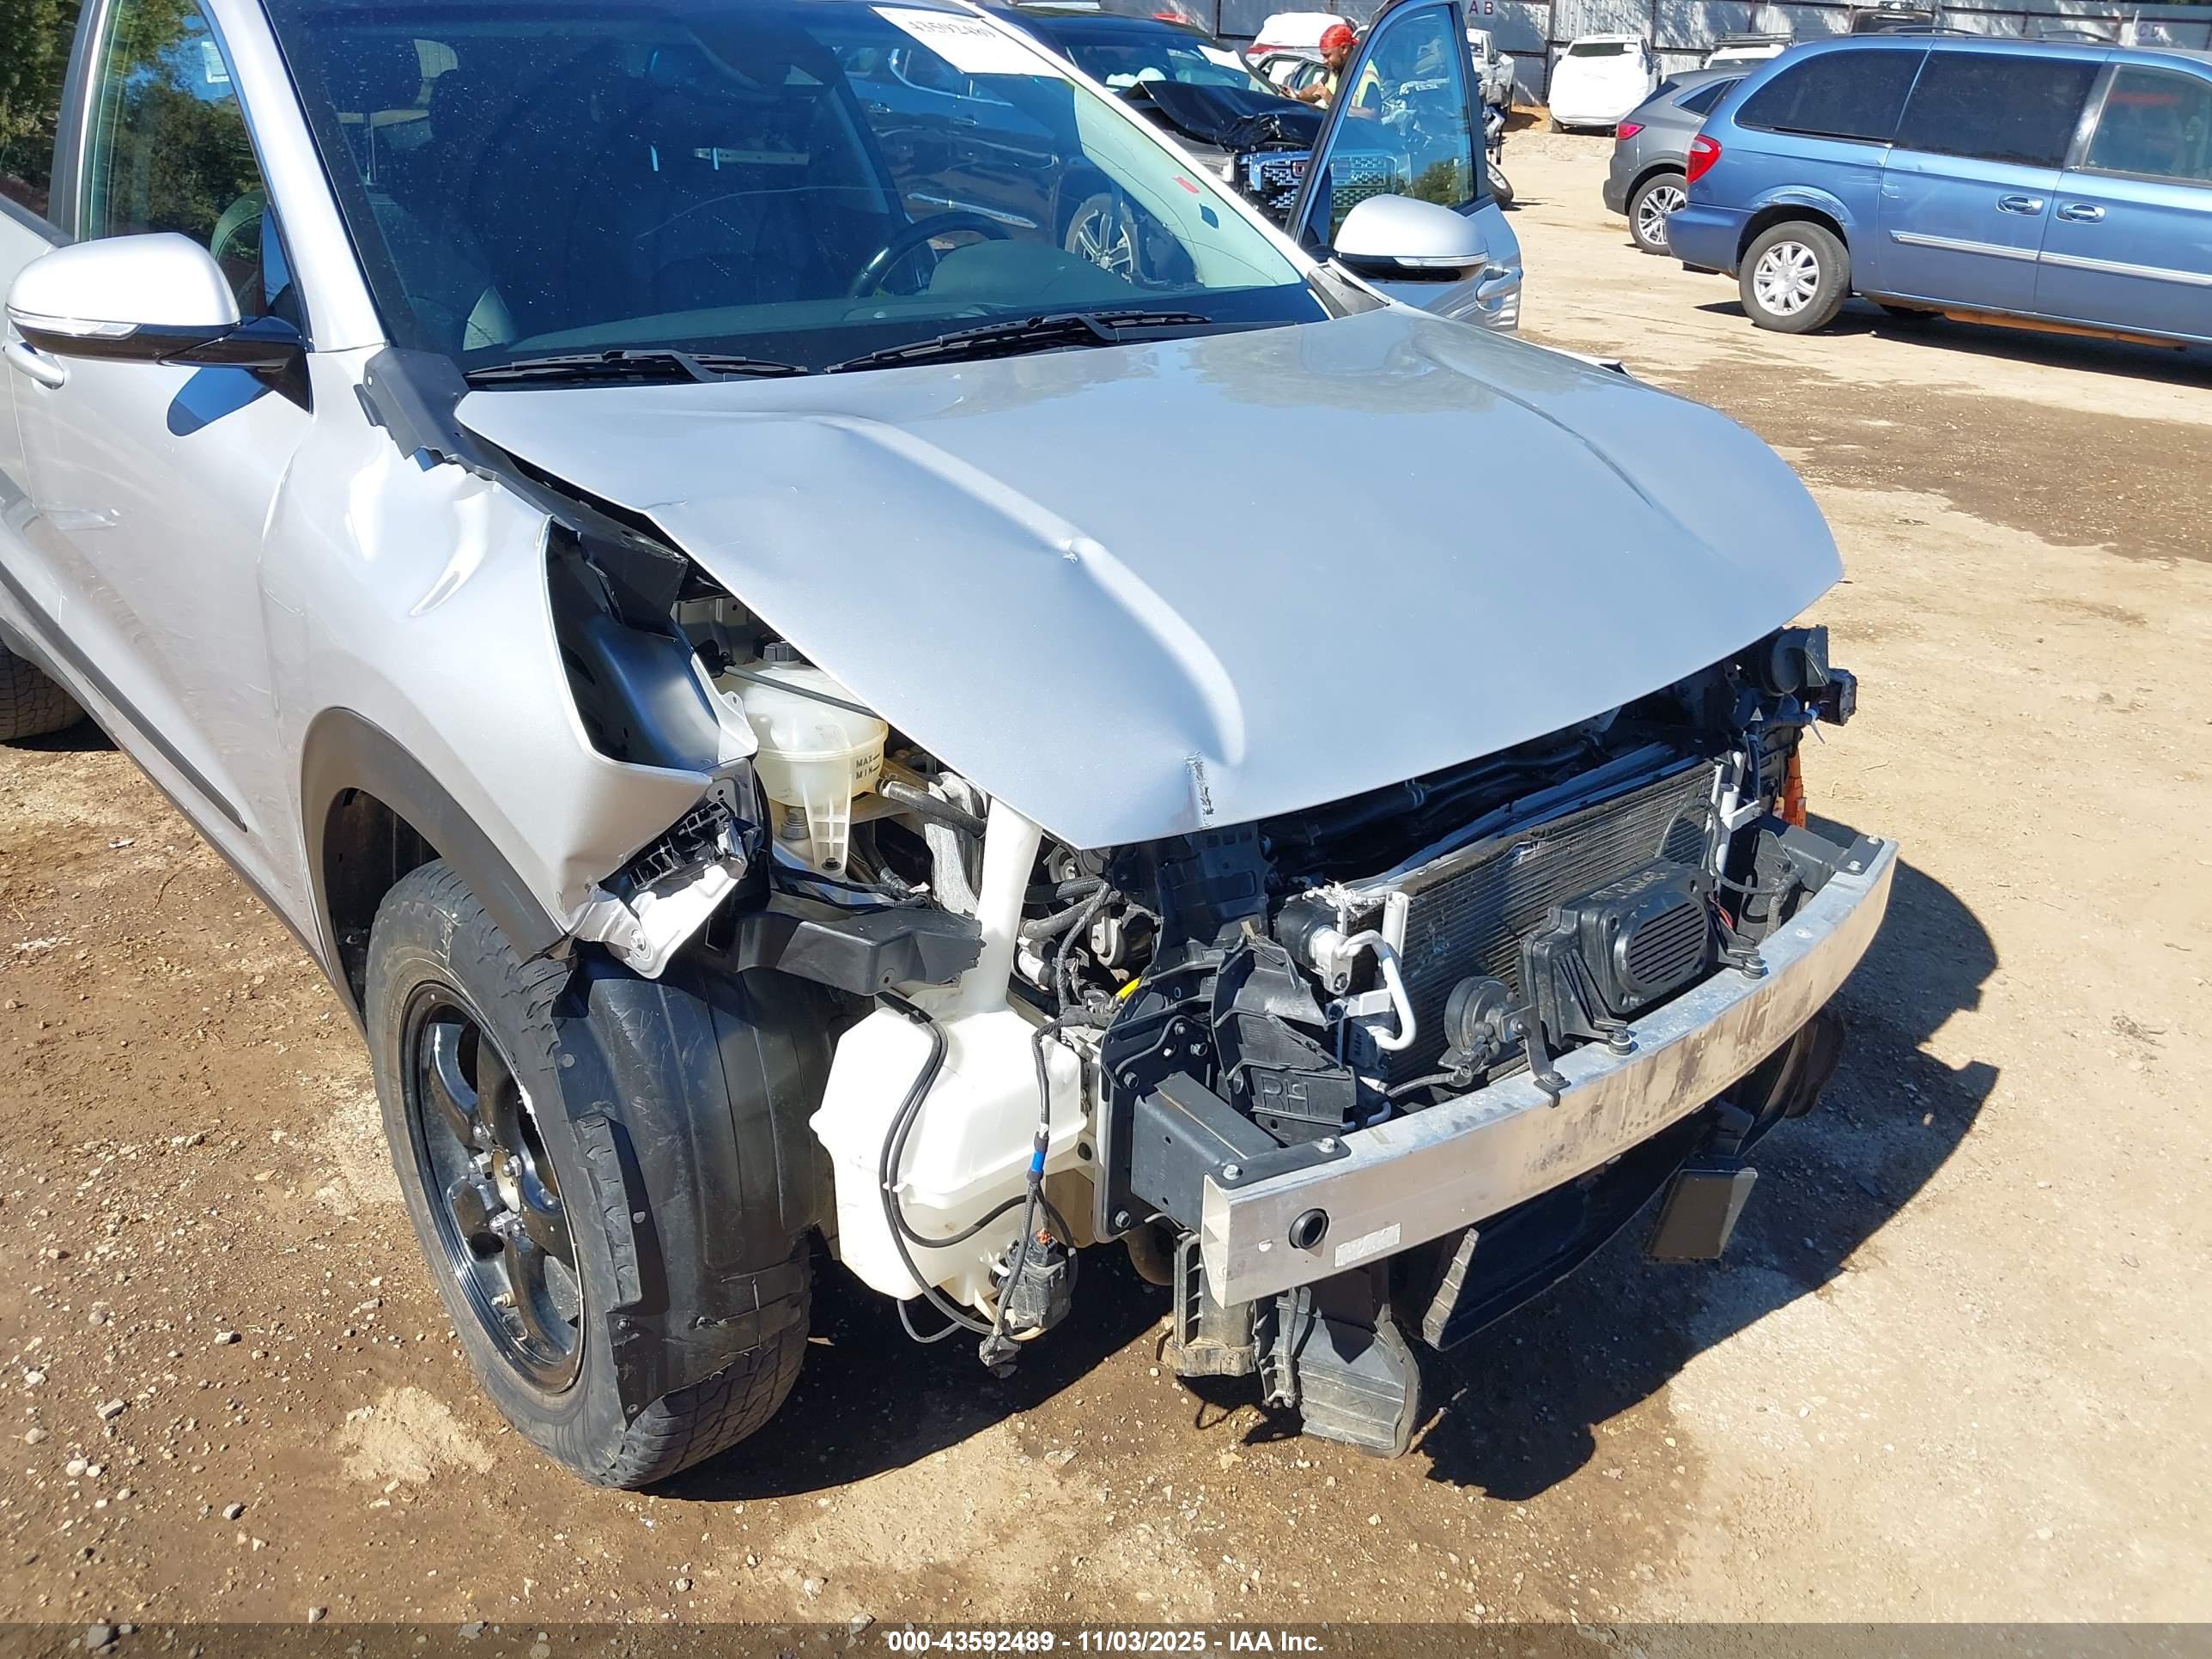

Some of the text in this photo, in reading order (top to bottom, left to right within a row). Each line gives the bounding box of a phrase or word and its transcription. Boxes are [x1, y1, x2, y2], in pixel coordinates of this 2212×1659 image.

[855, 754, 873, 769] MAX
[855, 766, 873, 780] MIN
[1260, 1074, 1311, 1116] RH
